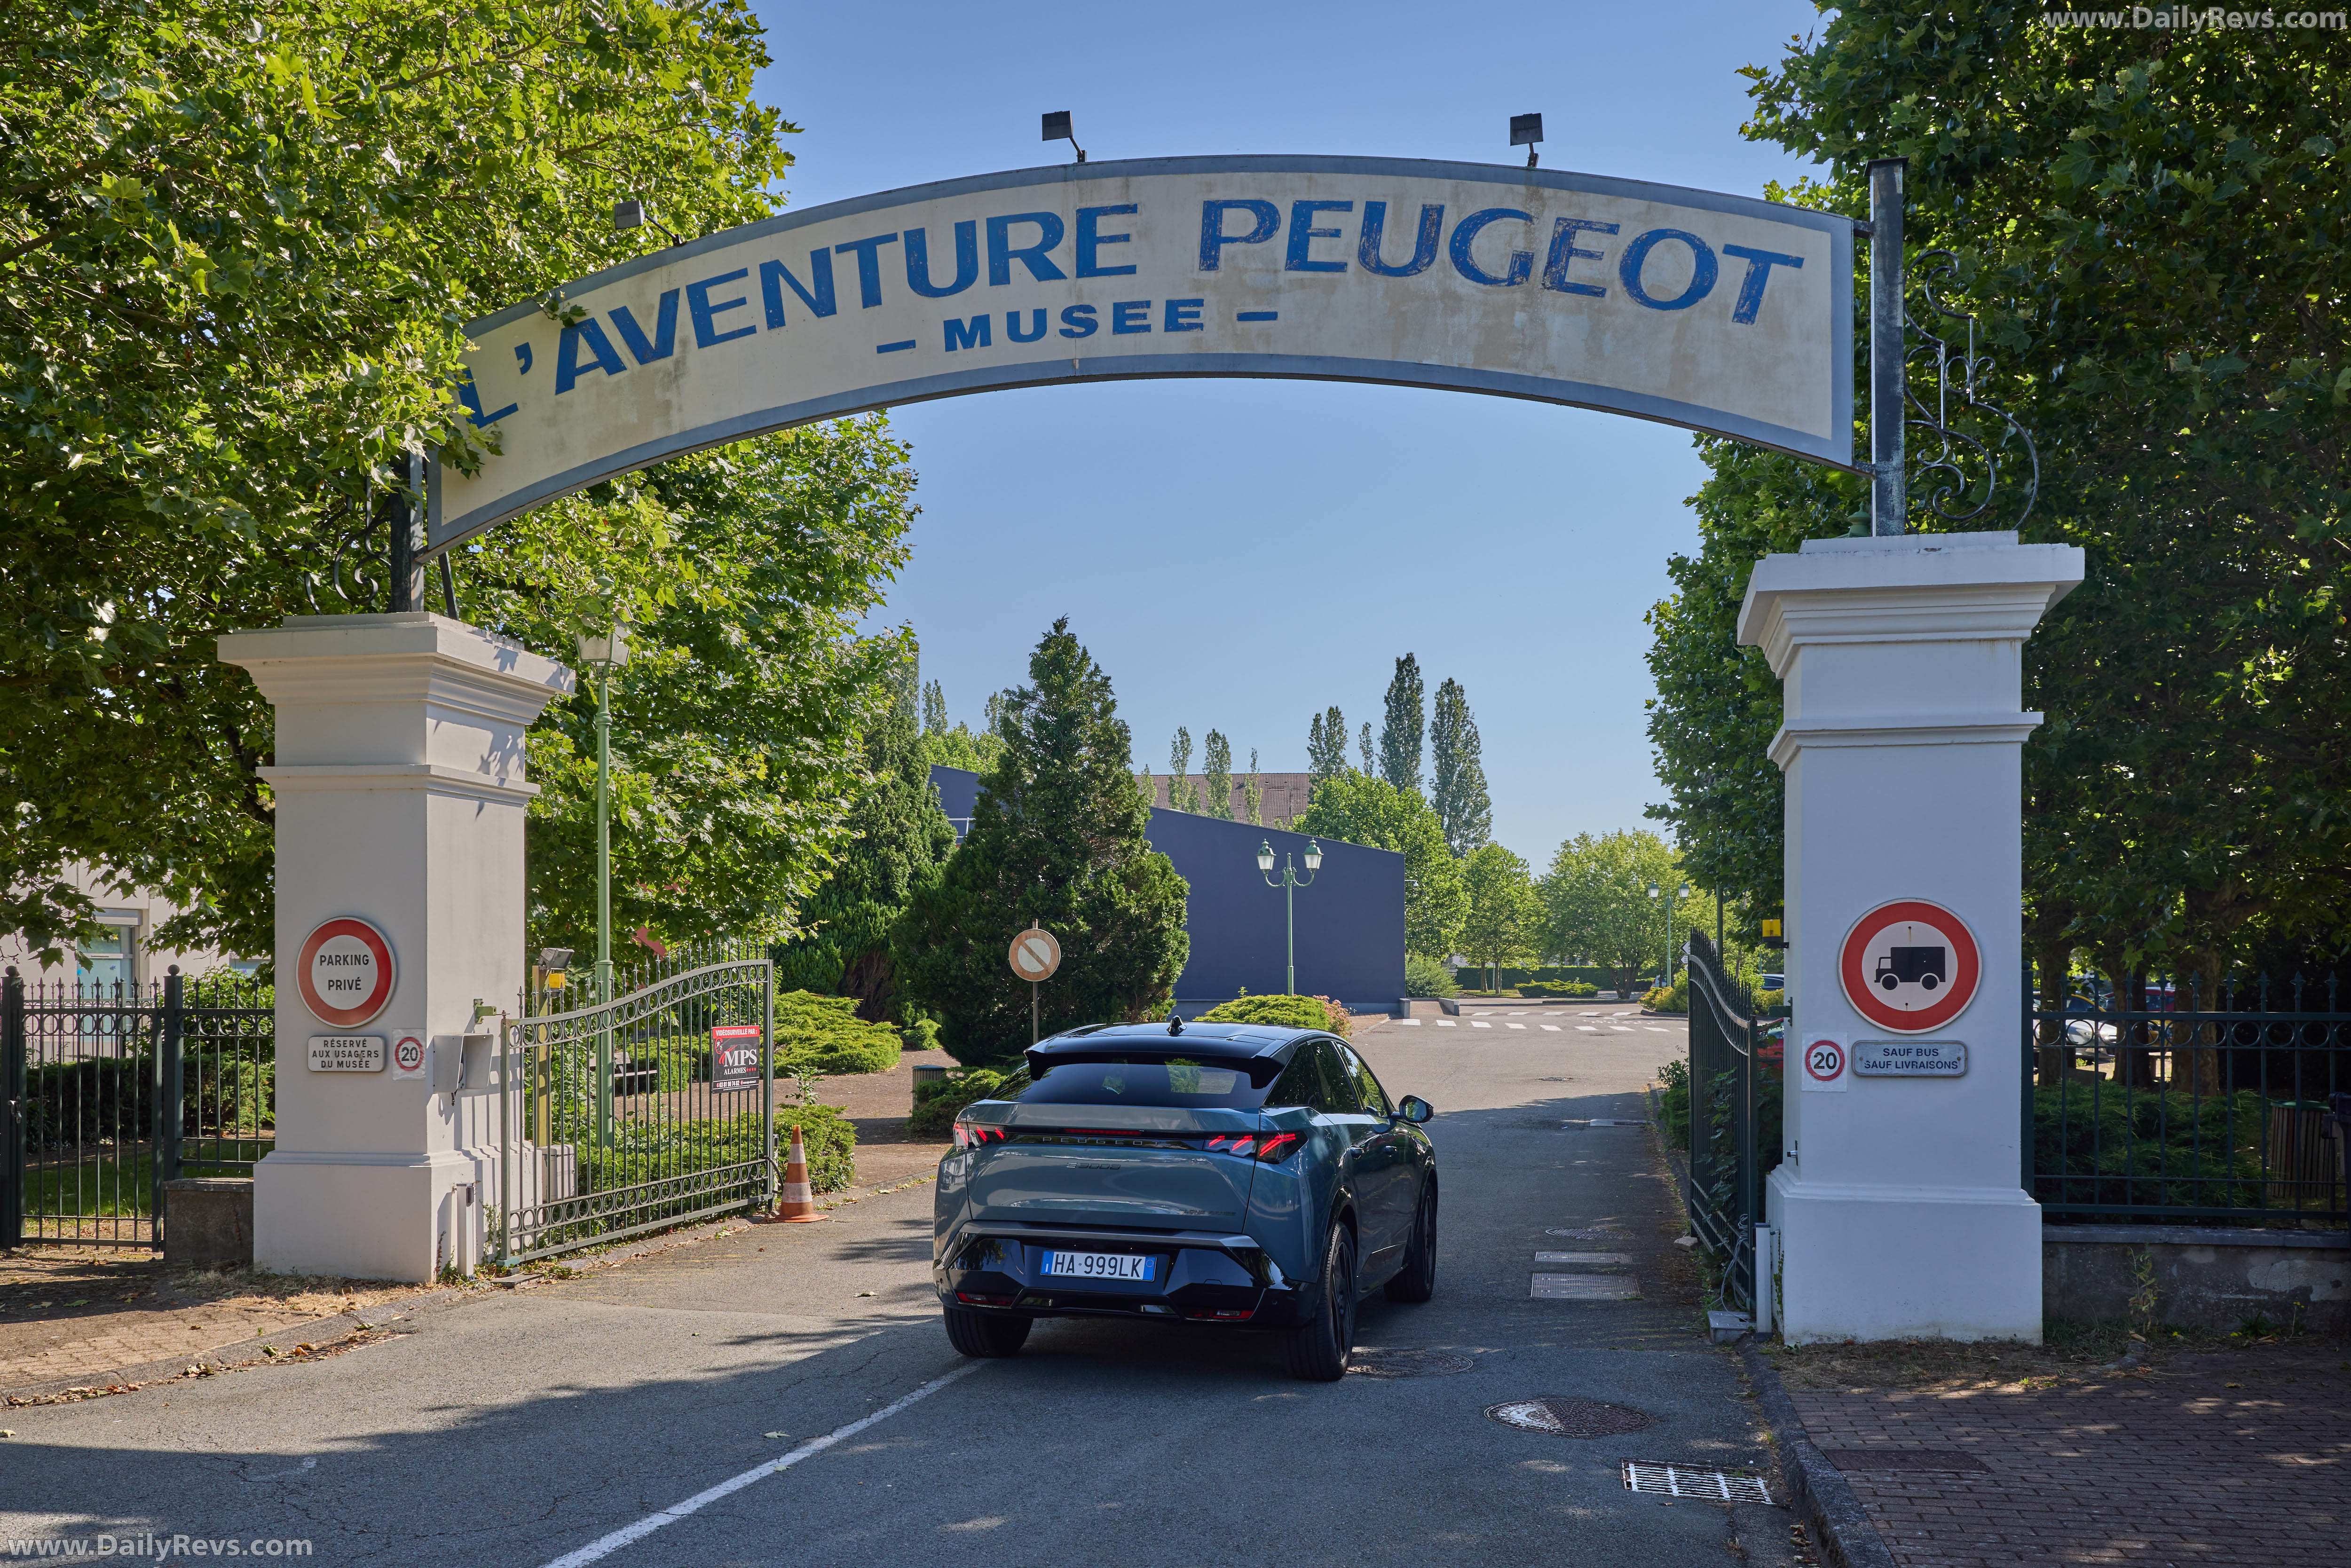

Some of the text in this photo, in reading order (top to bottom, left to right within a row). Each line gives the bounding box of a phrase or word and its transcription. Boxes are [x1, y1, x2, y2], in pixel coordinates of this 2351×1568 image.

[454, 199, 1804, 429] L'AVENTURE PEUGEOT
[943, 298, 1204, 353] MUSEE
[320, 954, 369, 966] PARKING
[328, 977, 362, 991] PRIVÉ
[716, 1027, 748, 1036] VIDÉOSURVEILLÉ
[323, 1038, 367, 1048] RÉSERVÉ
[401, 1047, 418, 1062] 20
[724, 1049, 757, 1067] MPS
[1883, 1048, 1939, 1056] SAUF BUS
[337, 1059, 371, 1068] MUSÉE
[1813, 1052, 1837, 1070] 20
[1864, 1061, 1958, 1070] SAUF LIVRAISONS
[1042, 1137, 1161, 1146] PEUGEOT
[1054, 1254, 1075, 1274] HA
[1084, 1255, 1143, 1277] 999LK
